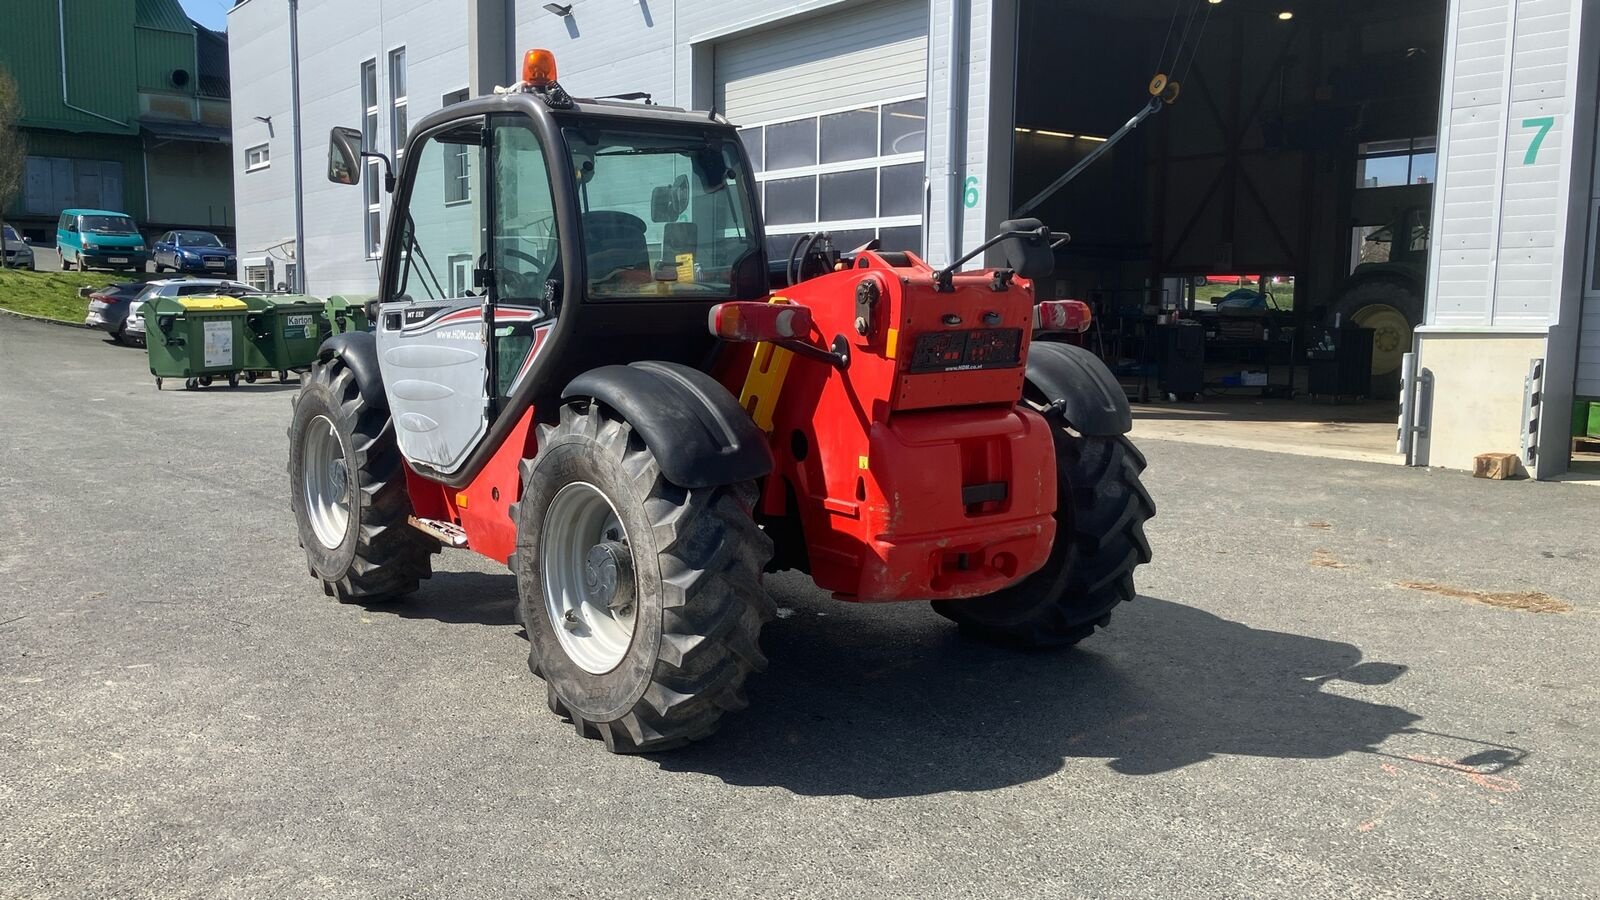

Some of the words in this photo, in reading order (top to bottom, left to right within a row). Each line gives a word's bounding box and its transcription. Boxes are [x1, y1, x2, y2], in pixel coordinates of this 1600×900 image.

[1522, 116, 1554, 165] 7
[963, 175, 979, 208] 6
[288, 315, 313, 326] Karton
